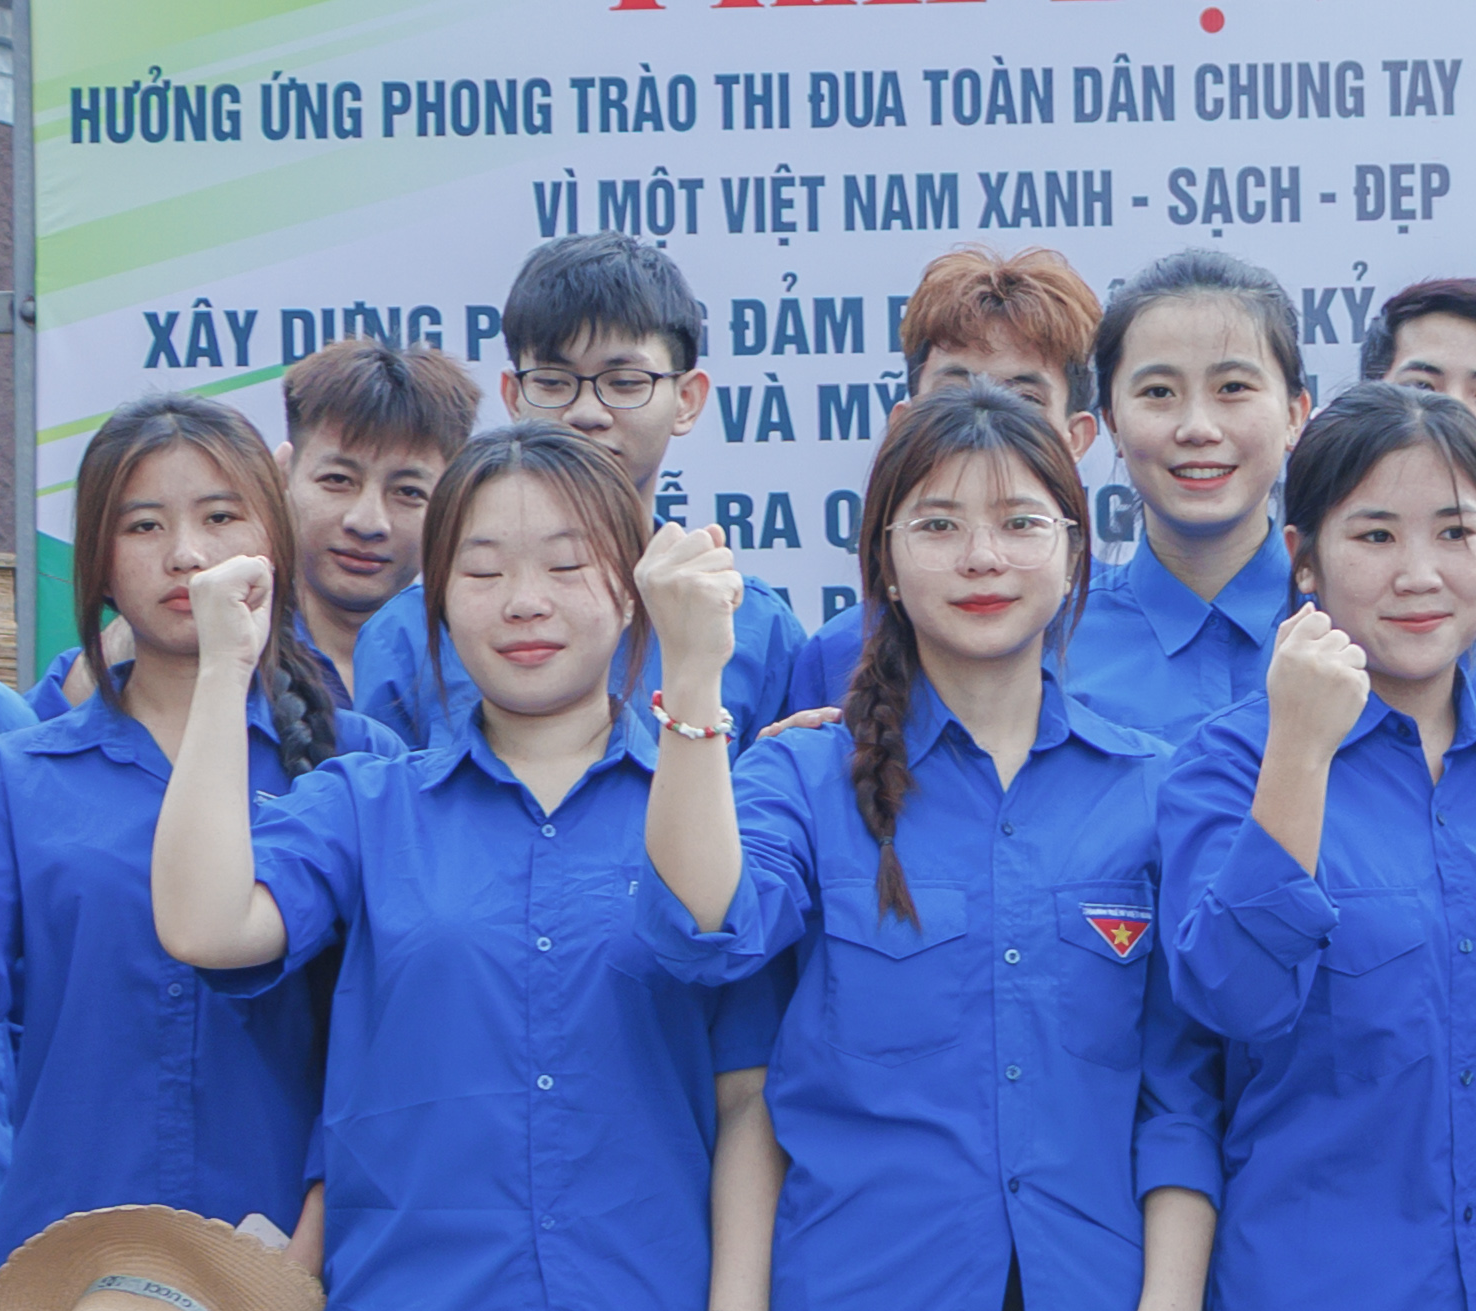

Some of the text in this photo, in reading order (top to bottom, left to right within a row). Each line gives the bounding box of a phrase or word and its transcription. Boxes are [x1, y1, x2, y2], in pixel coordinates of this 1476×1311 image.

[70, 65, 242, 144] HƯỞNG
[260, 67, 363, 140] ỨNG
[382, 77, 553, 137] PHONG
[569, 63, 697, 134] TRÀO
[714, 72, 790, 130] THI
[808, 70, 906, 128] ĐUA
[923, 55, 1054, 126] TOÀN
[1073, 52, 1175, 124] DÂN
[1194, 60, 1365, 121] CHUNG
[1382, 59, 1463, 118] TAY
[533, 168, 578, 239] VÌ
[597, 166, 703, 248] MỘT
[721, 163, 826, 246] VIỆT
[842, 173, 959, 235] NAM
[977, 170, 1114, 230] XANH
[1167, 166, 1301, 238] SẠCH
[1354, 163, 1451, 235] ĐẸP
[143, 297, 259, 369] XÂY
[729, 272, 865, 356] ĐẢM
[715, 372, 795, 442] VÀ
[715, 492, 802, 549] RA
